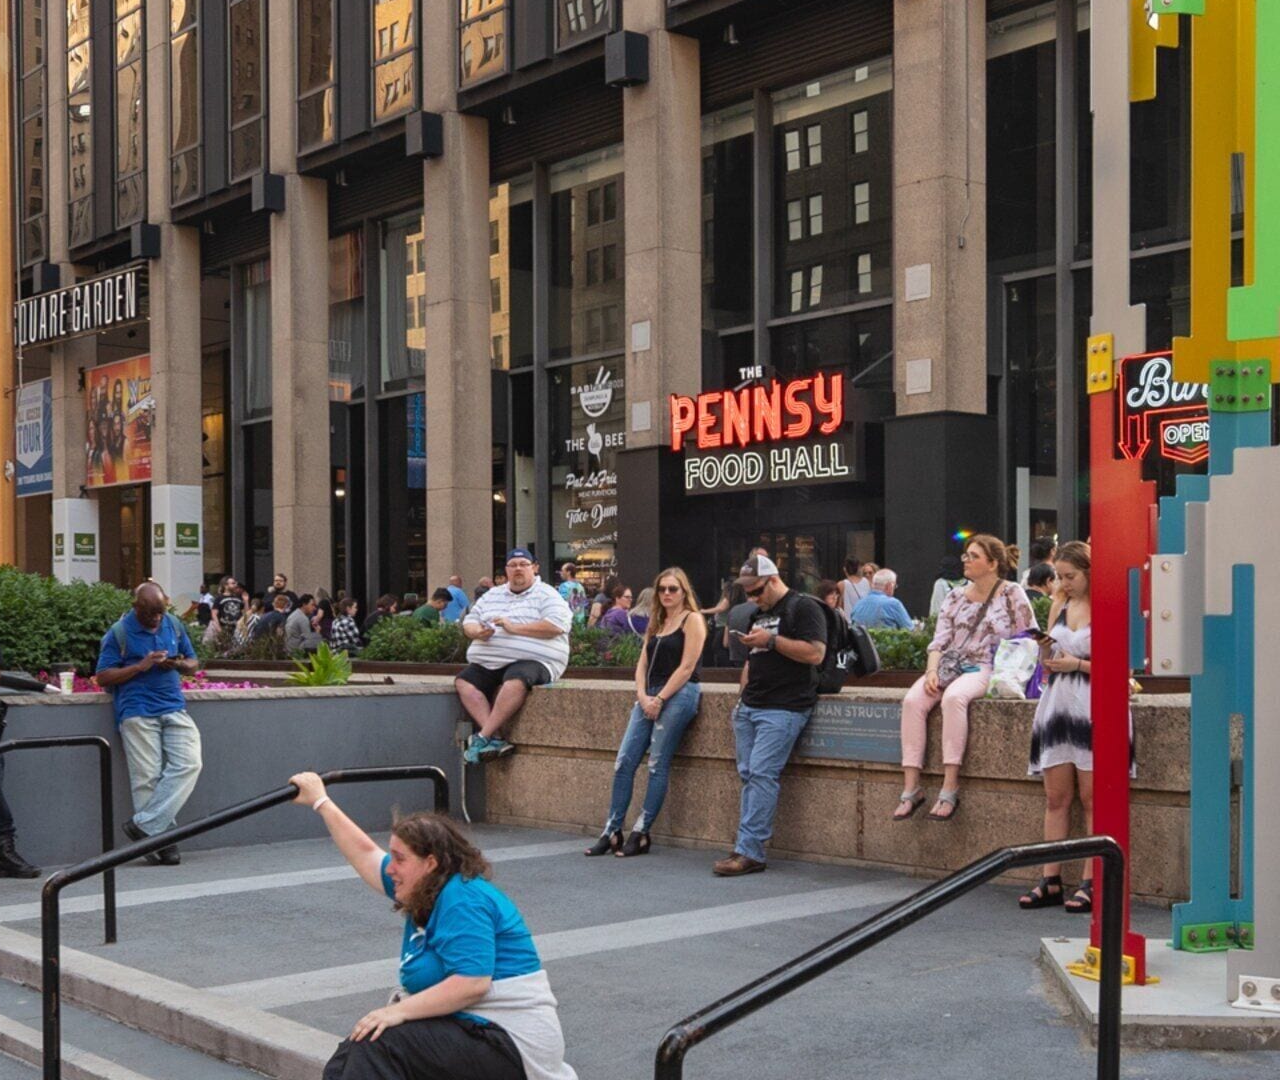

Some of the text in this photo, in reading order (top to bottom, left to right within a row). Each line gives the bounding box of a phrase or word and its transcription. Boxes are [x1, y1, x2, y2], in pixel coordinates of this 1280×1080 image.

[13, 291, 67, 348] QUARE
[72, 271, 136, 332] GARDEN
[739, 365, 763, 380] THE
[669, 371, 843, 452] PENNSY
[565, 431, 627, 452] THE BEE
[685, 443, 848, 489] FOOD HALL
[590, 503, 618, 529] Dum
